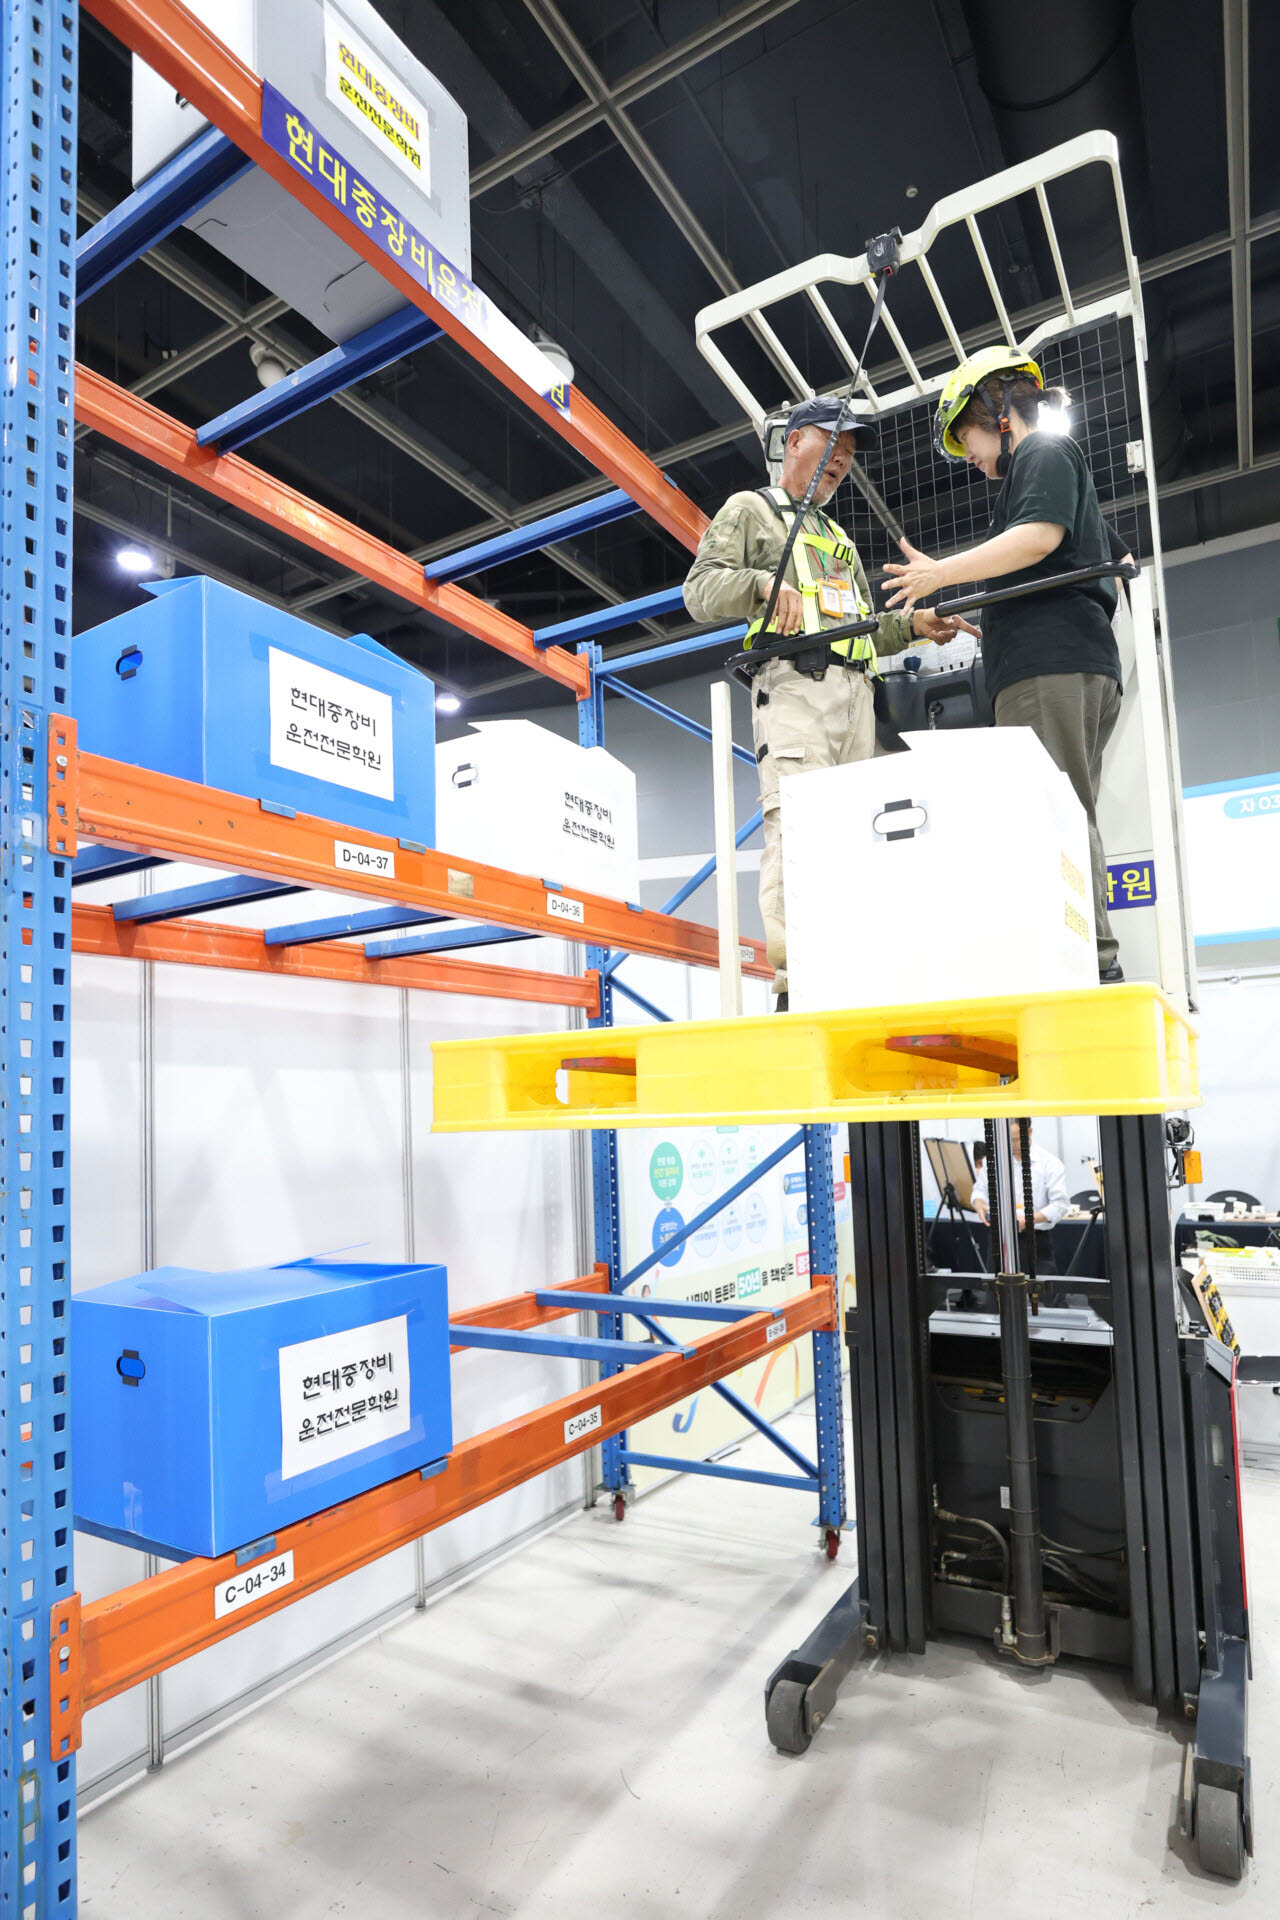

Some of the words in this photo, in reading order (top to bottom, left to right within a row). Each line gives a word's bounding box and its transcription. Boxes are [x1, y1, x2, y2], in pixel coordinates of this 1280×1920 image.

[338, 40, 420, 140] 현대중장비
[339, 74, 421, 170] 운전전문학원
[291, 687, 376, 737] 현대중장비
[286, 723, 381, 771] 운전전문학원
[565, 791, 612, 824] 현대중장비
[1240, 798, 1255, 813] 자
[563, 818, 615, 849] 운전전문학원
[343, 848, 389, 870] D-04-37
[552, 899, 581, 917] D-04-36
[715, 1281, 736, 1303] 든든한
[303, 1352, 393, 1401] 현대중장비
[299, 1388, 398, 1442] 운전전문학원
[569, 1411, 598, 1435] C-04-35
[225, 1561, 286, 1603] C-04-34
